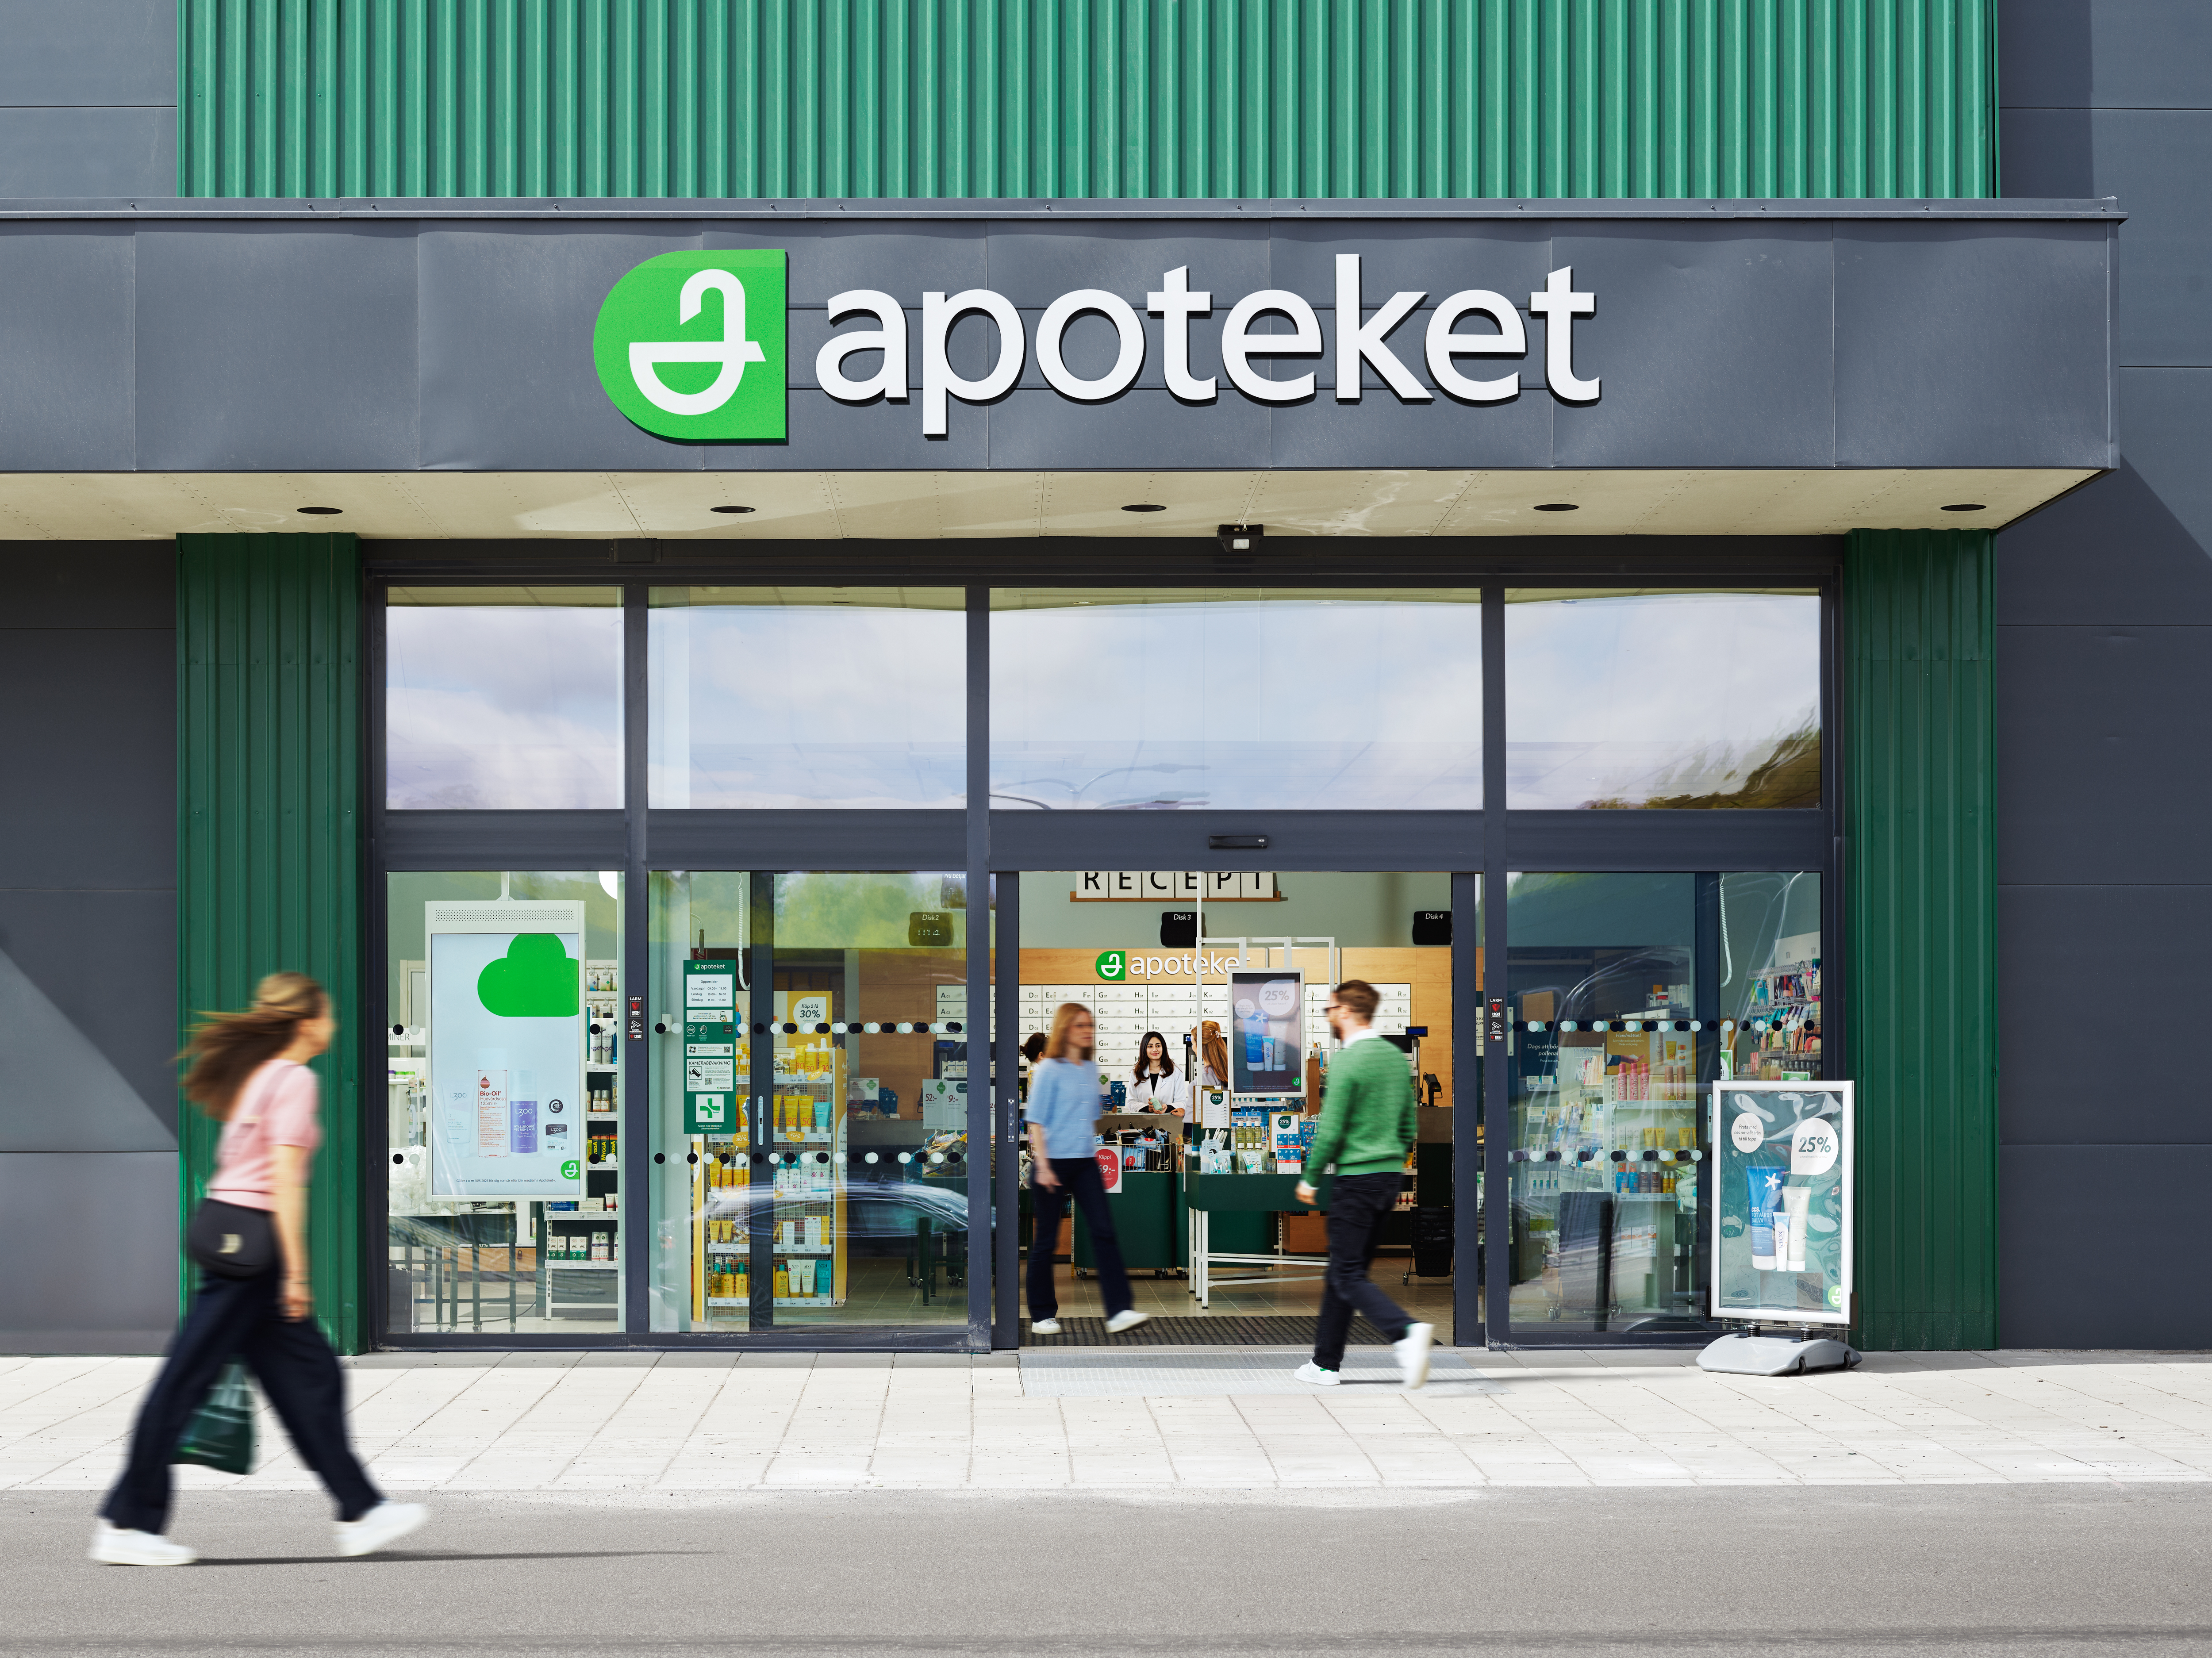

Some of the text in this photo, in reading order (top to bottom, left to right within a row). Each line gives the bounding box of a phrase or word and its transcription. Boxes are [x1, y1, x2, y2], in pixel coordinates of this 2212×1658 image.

[814, 254, 1601, 436] apoteket
[1129, 951, 1250, 980] apoteke
[1264, 990, 1290, 1001] 25%
[515, 1108, 533, 1117] L300
[1798, 1137, 1831, 1153] 25%
